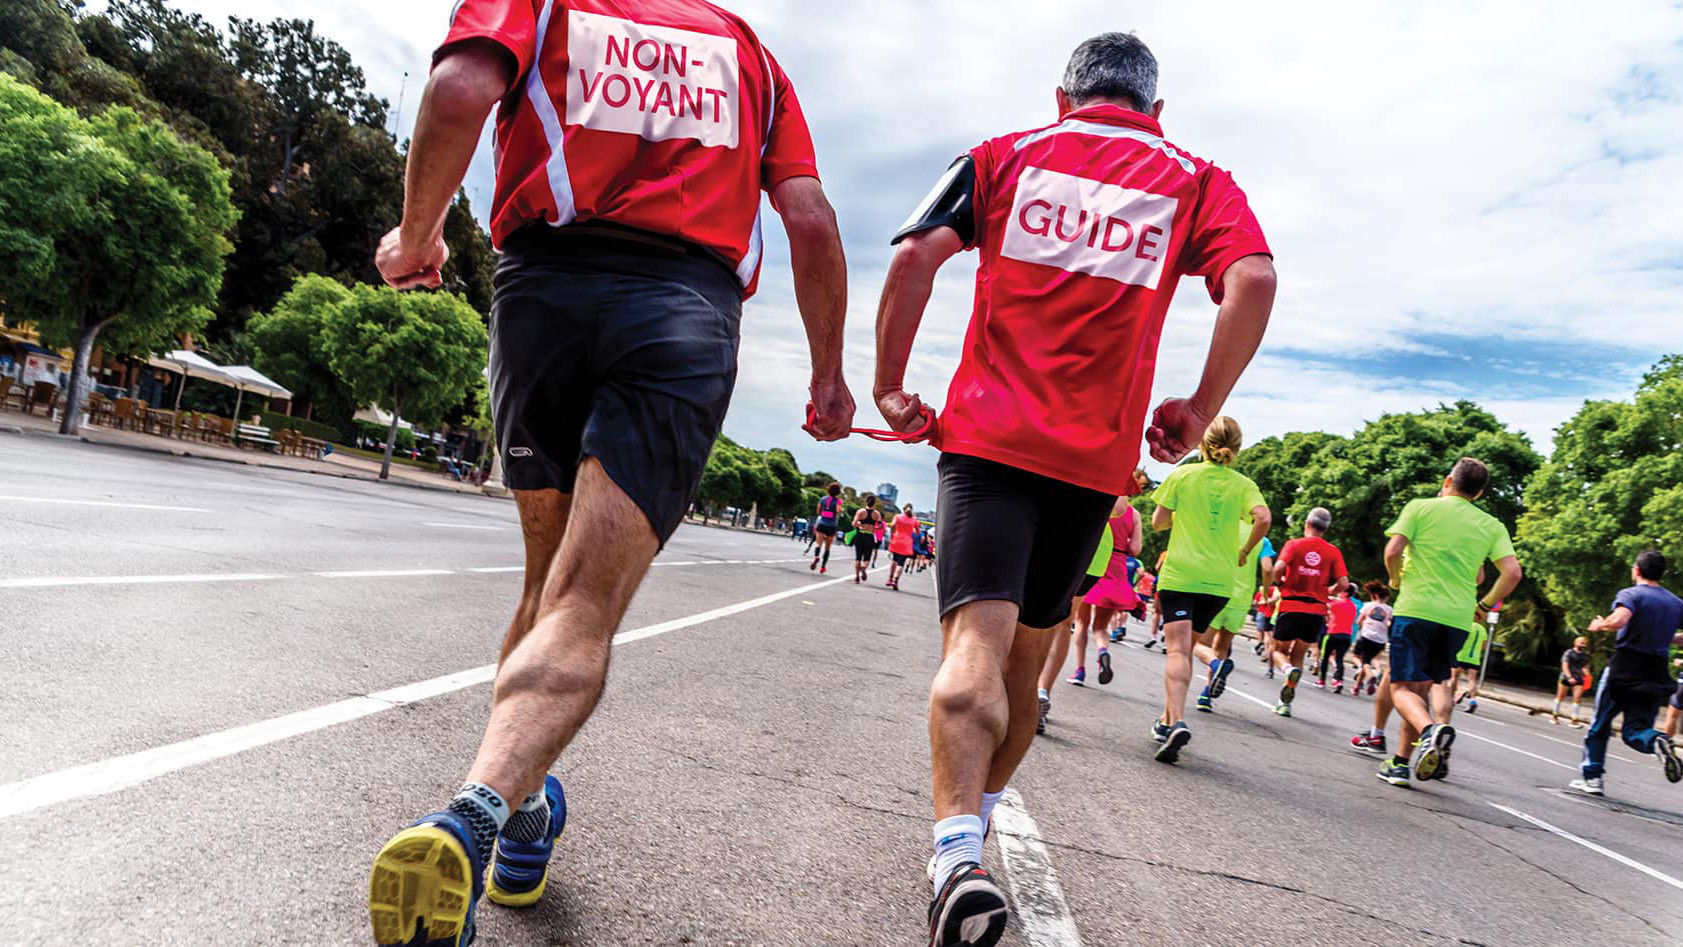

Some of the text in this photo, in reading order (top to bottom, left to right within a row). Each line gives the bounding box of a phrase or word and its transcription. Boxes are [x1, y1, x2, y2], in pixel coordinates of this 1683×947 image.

[605, 35, 704, 77] NON-
[579, 69, 727, 122] VOYANT
[1019, 199, 1163, 262] GUIDE
